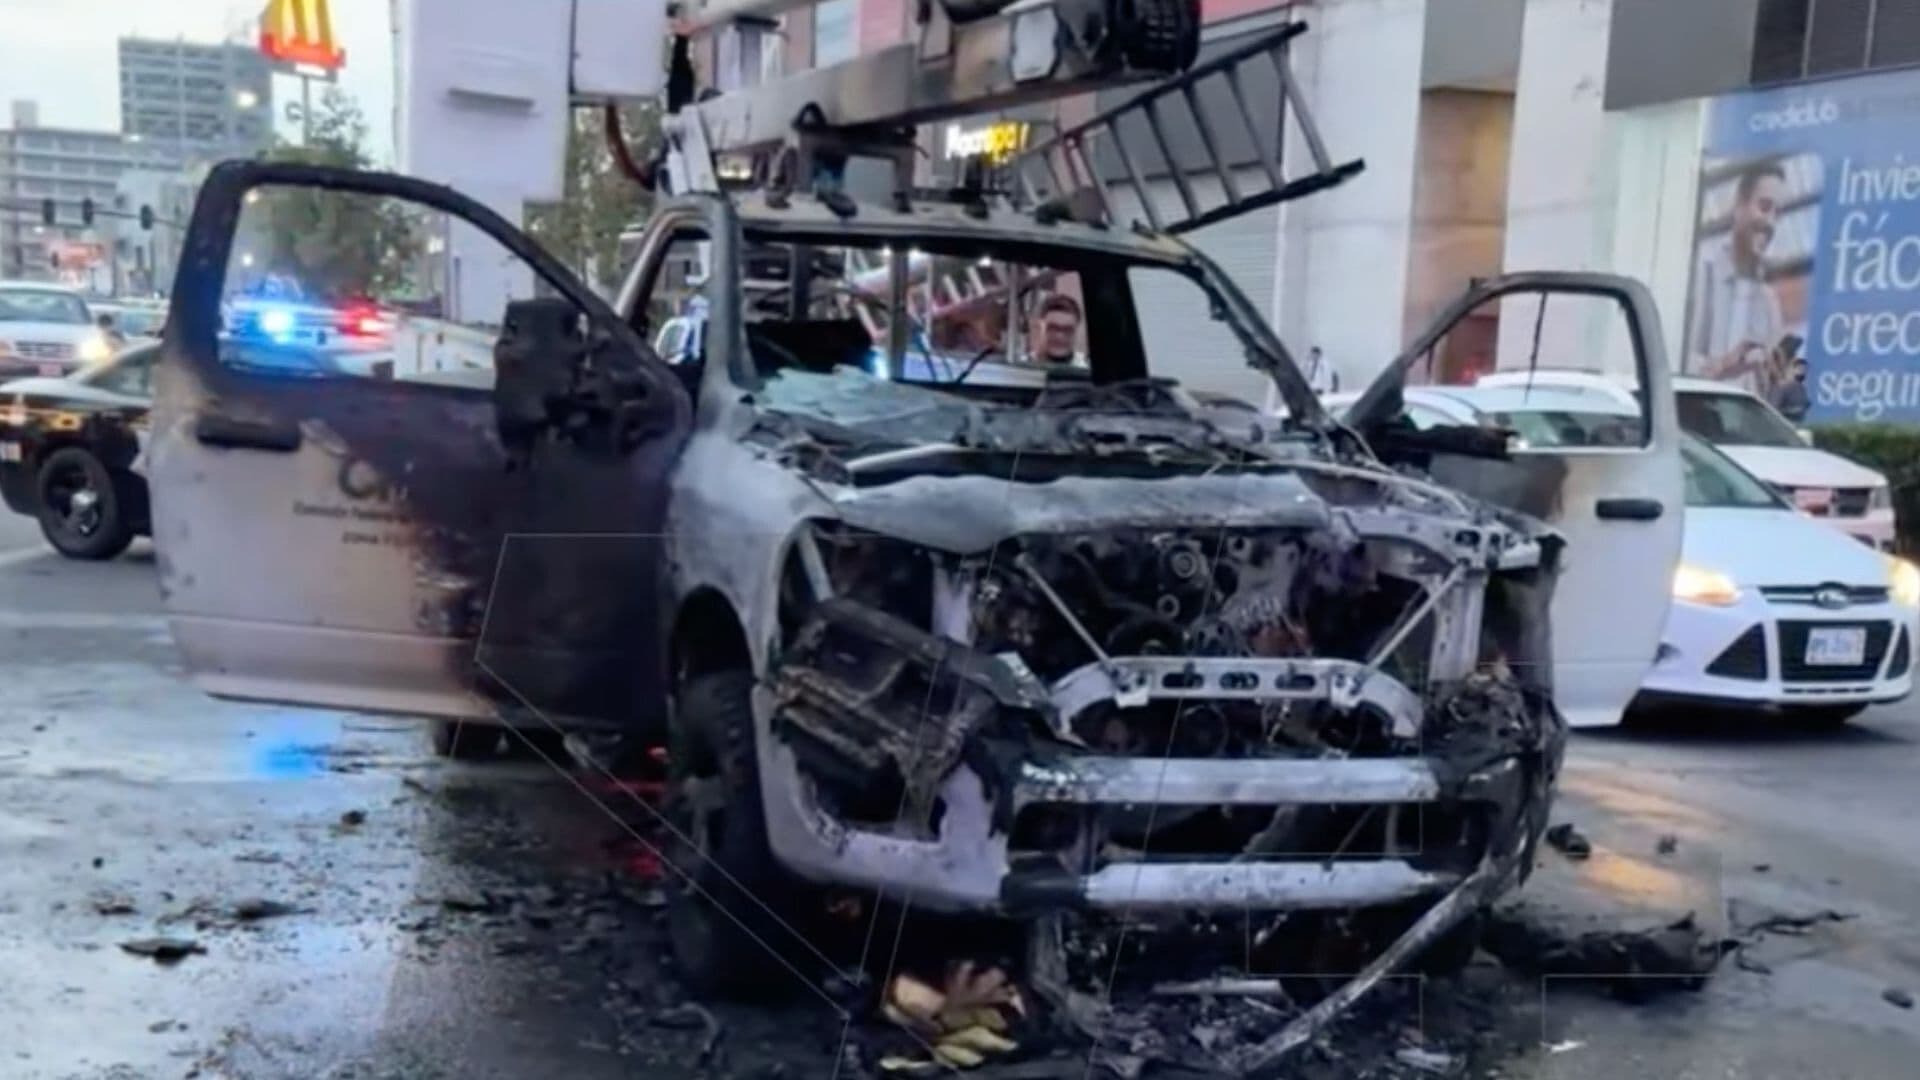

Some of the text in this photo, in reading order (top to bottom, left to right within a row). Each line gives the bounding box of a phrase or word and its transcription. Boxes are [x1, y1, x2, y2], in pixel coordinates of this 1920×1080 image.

[1839, 154, 1920, 204] Invie
[1832, 211, 1920, 291] fác
[1822, 311, 1920, 355] crec
